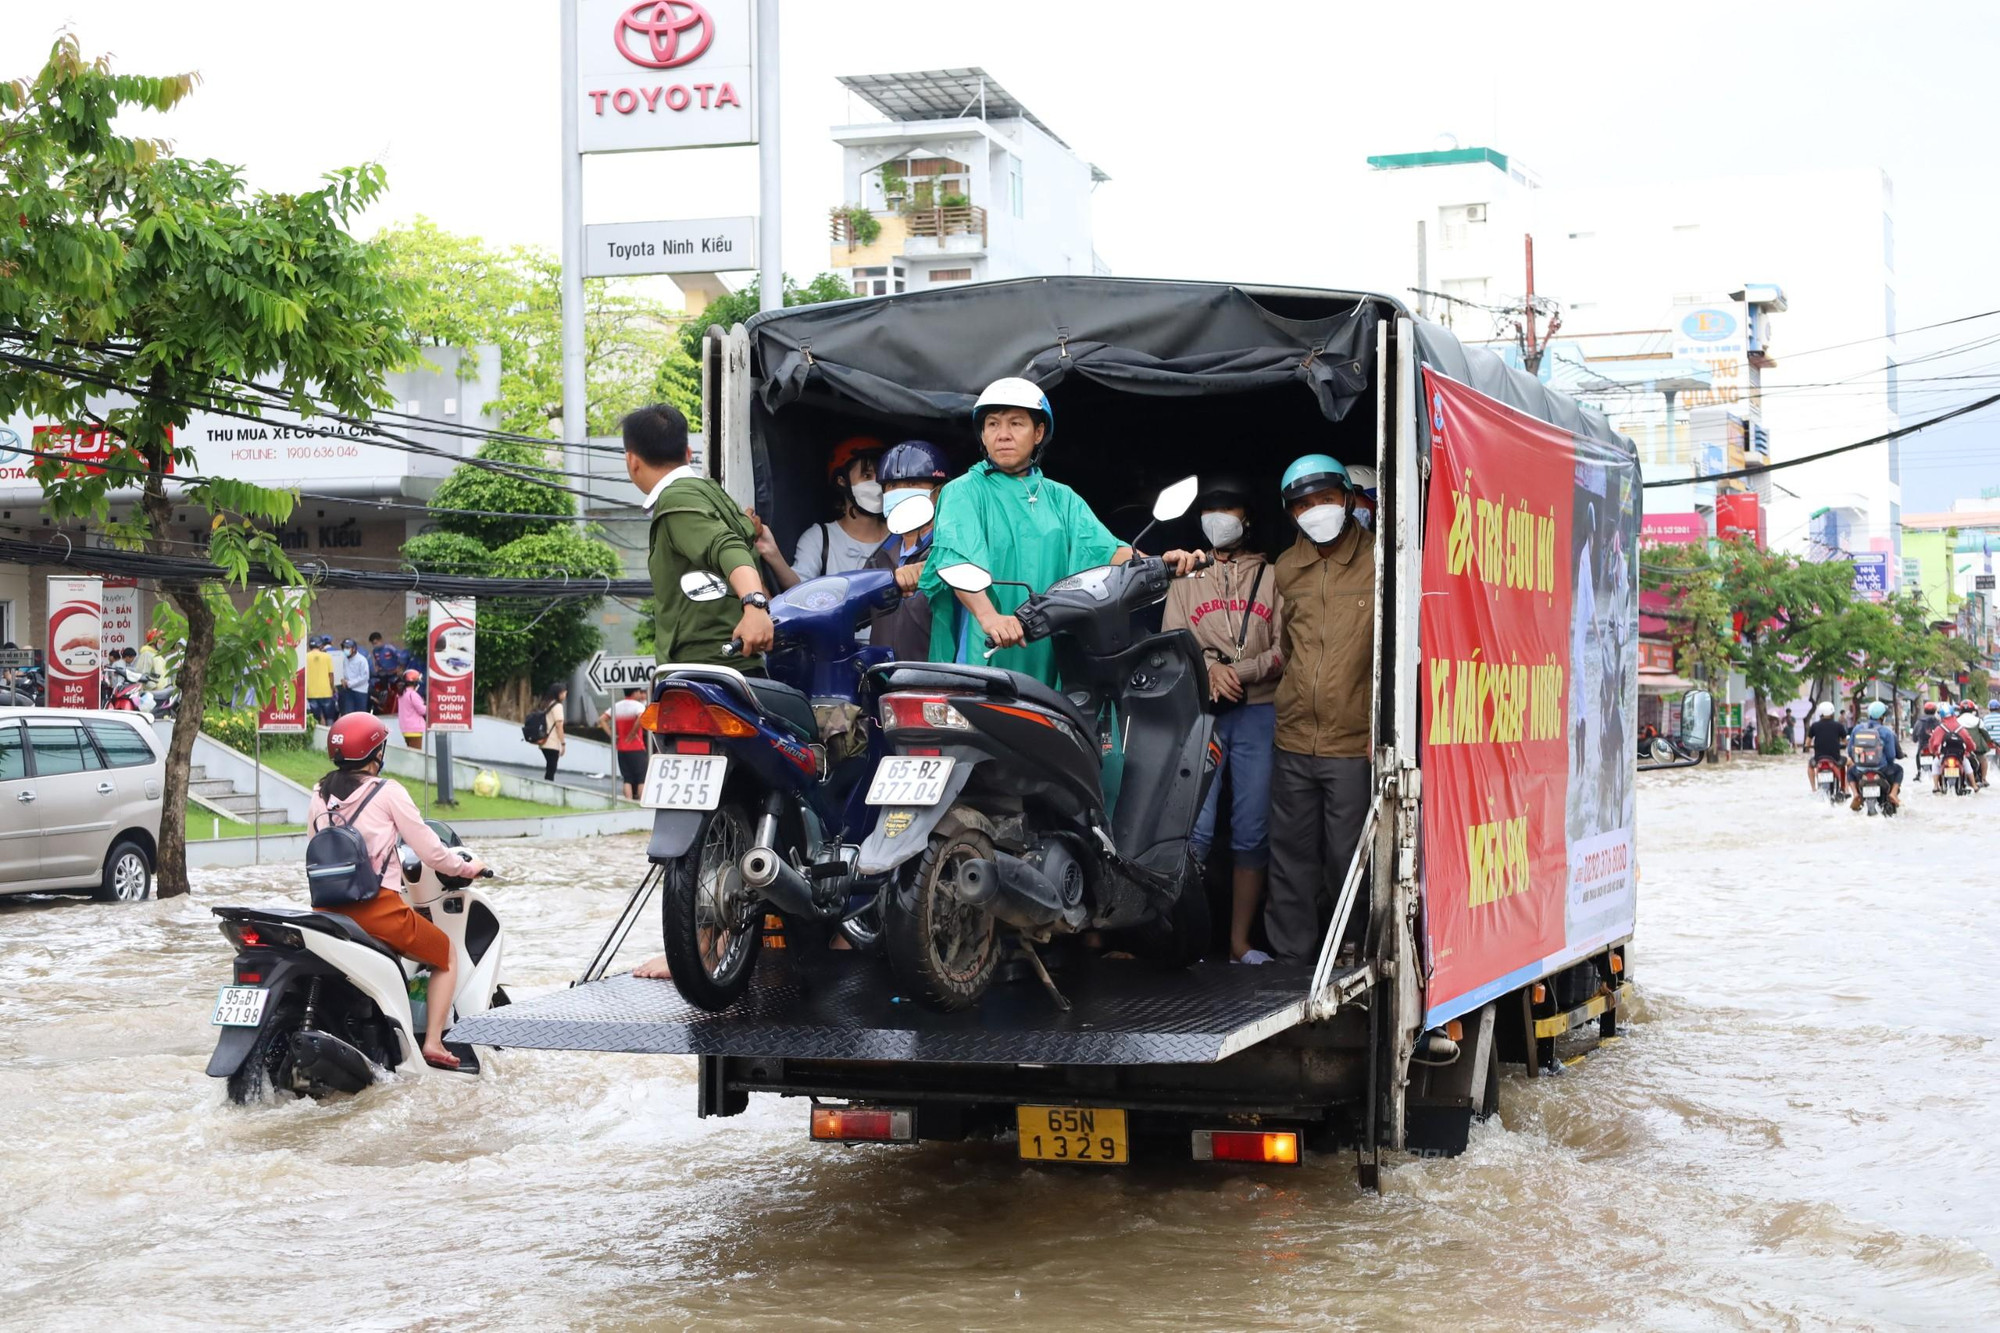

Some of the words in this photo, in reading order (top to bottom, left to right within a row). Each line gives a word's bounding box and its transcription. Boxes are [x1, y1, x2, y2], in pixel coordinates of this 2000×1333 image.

[588, 82, 741, 116] TOYOTA
[607, 241, 655, 260] Toyota
[663, 239, 693, 255] Ninh
[702, 235, 732, 253] Kiều
[207, 429, 232, 442] THU
[237, 428, 267, 441] MUA
[273, 428, 290, 440] XE
[231, 448, 276, 460] HOTLINE:
[287, 447, 311, 459] 1900
[314, 446, 335, 458] 636
[337, 446, 358, 457] 046
[1448, 467, 1474, 578] HỖ
[1476, 493, 1504, 600] TRỢ
[1506, 498, 1534, 591] CỨU
[1537, 504, 1555, 608] HỘ
[116, 604, 132, 614] BÁN
[604, 660, 628, 683] LỐI
[629, 661, 657, 682] VÀO
[65, 683, 82, 693] BẢO
[1429, 658, 1450, 745] XE
[1453, 648, 1489, 744] MÁY
[1530, 652, 1563, 741] NƯỚC
[63, 693, 84, 704] HIỂM
[439, 703, 463, 711] CHÍNH
[270, 711, 295, 720] CHÍNH
[331, 734, 344, 744] 5G
[773, 737, 808, 763] Future
[659, 759, 711, 781] 65-H1
[887, 761, 941, 779] 65-B2
[655, 783, 709, 805] 1255
[873, 782, 938, 801] 377.04
[1506, 802, 1529, 897] PHÍ
[226, 990, 259, 1005] 95-B1
[216, 1007, 259, 1023] 621.98
[1048, 1109, 1094, 1132] 65N
[1033, 1135, 1114, 1159] 1329
